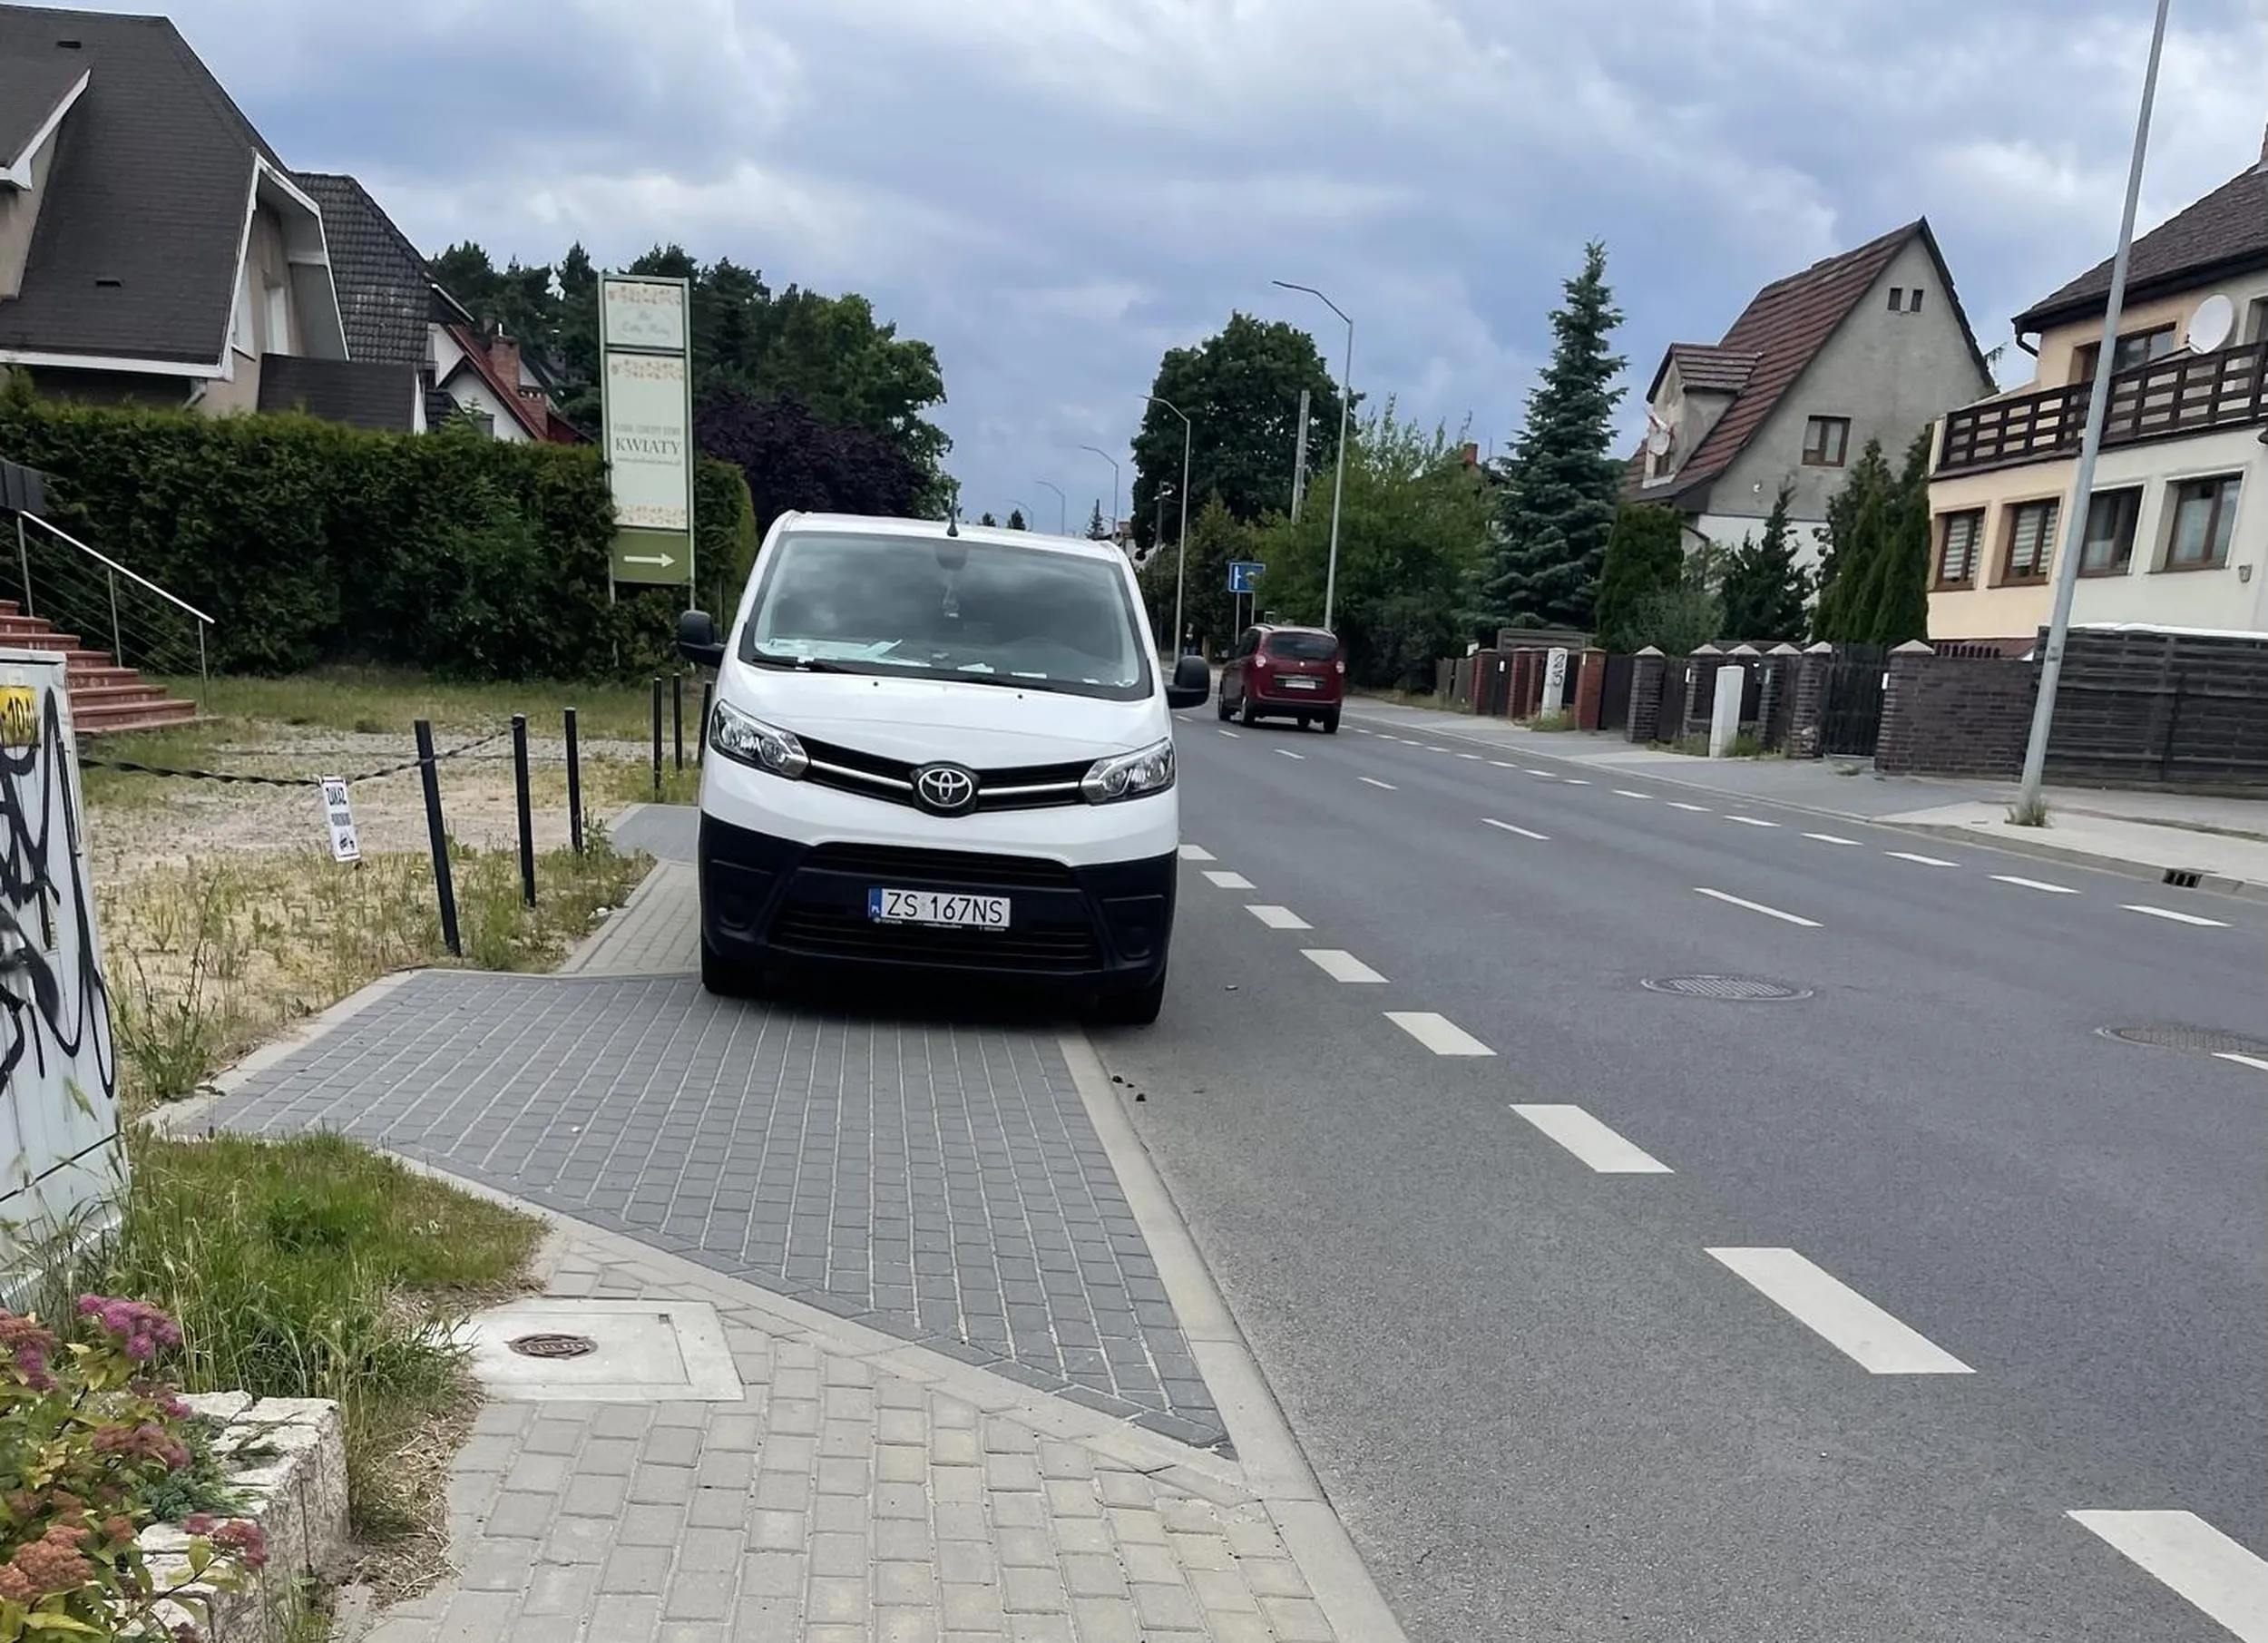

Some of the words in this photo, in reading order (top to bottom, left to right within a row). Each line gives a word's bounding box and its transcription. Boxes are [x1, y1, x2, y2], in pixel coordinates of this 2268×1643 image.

[616, 437, 681, 455] KWIATY
[886, 892, 918, 917] ZS
[930, 895, 1002, 924] 167NS
